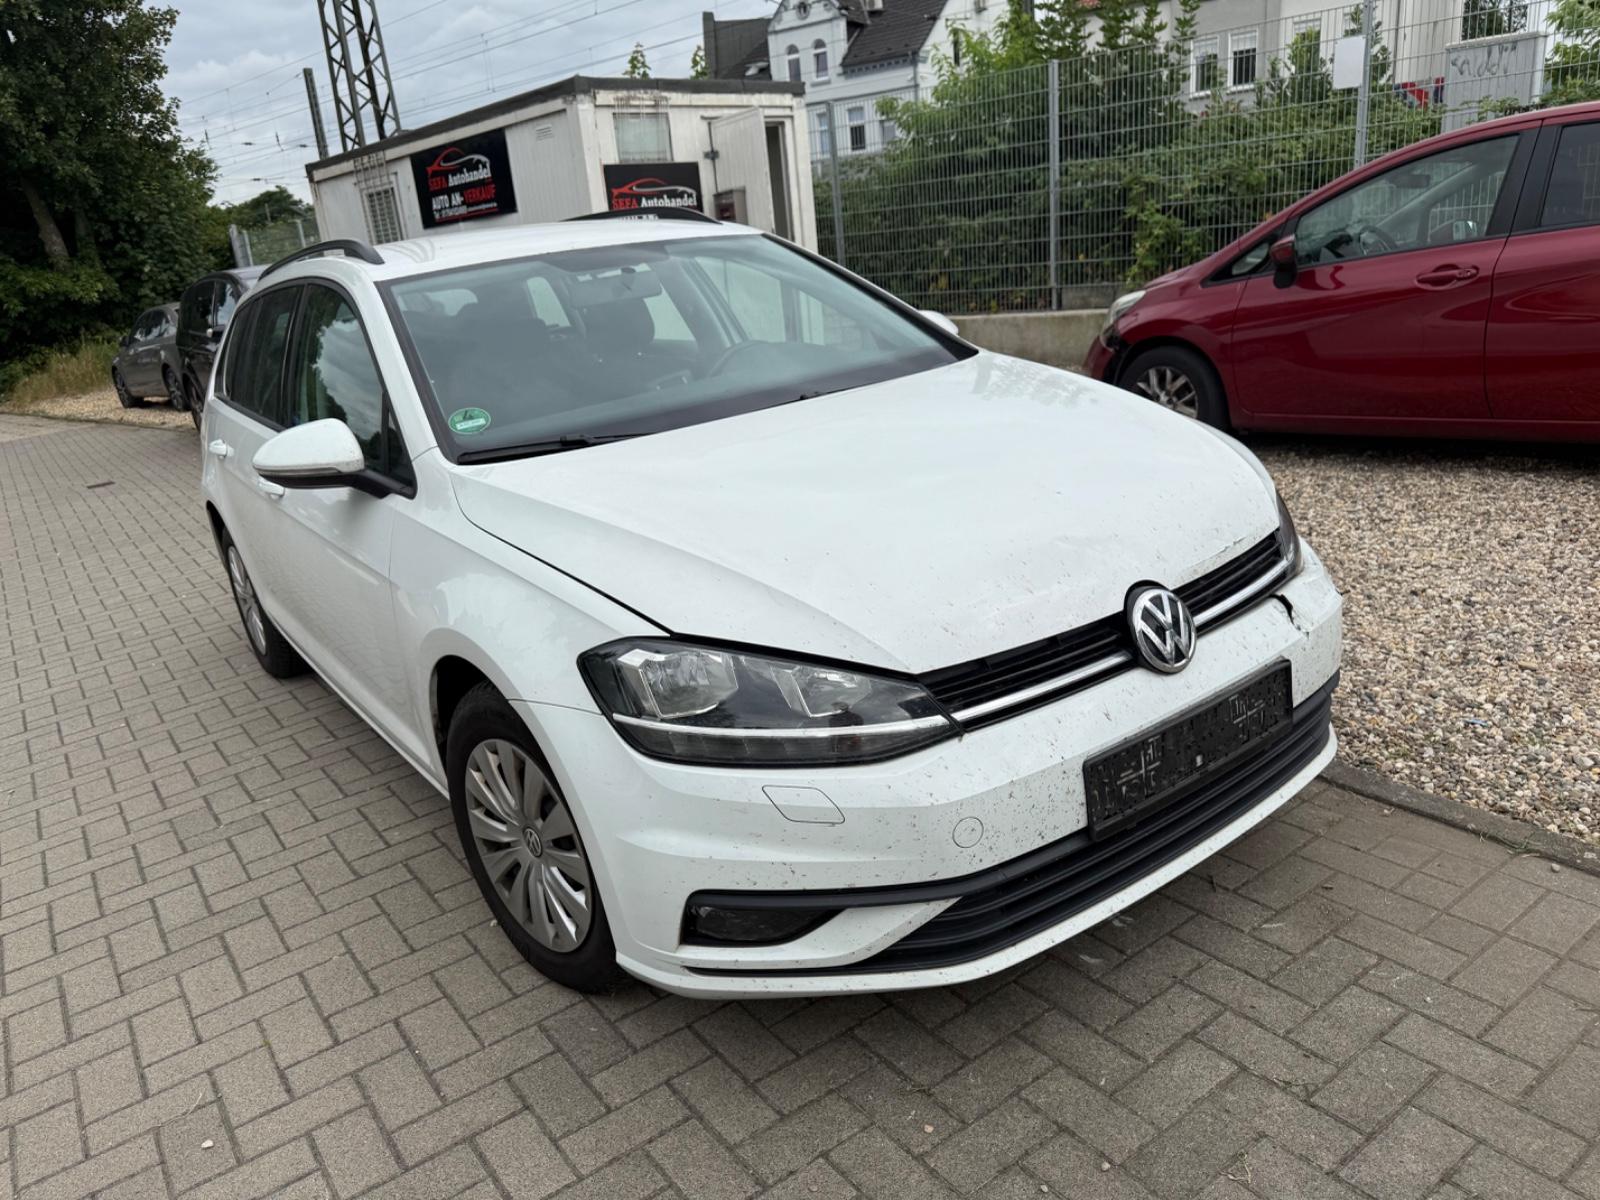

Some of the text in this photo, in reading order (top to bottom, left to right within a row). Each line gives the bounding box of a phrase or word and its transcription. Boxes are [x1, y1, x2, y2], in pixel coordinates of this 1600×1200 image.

[448, 163, 491, 187] Autohandel
[432, 195, 449, 210] AUTO
[641, 193, 697, 208] Autohandel
[1132, 588, 1197, 673] VW
